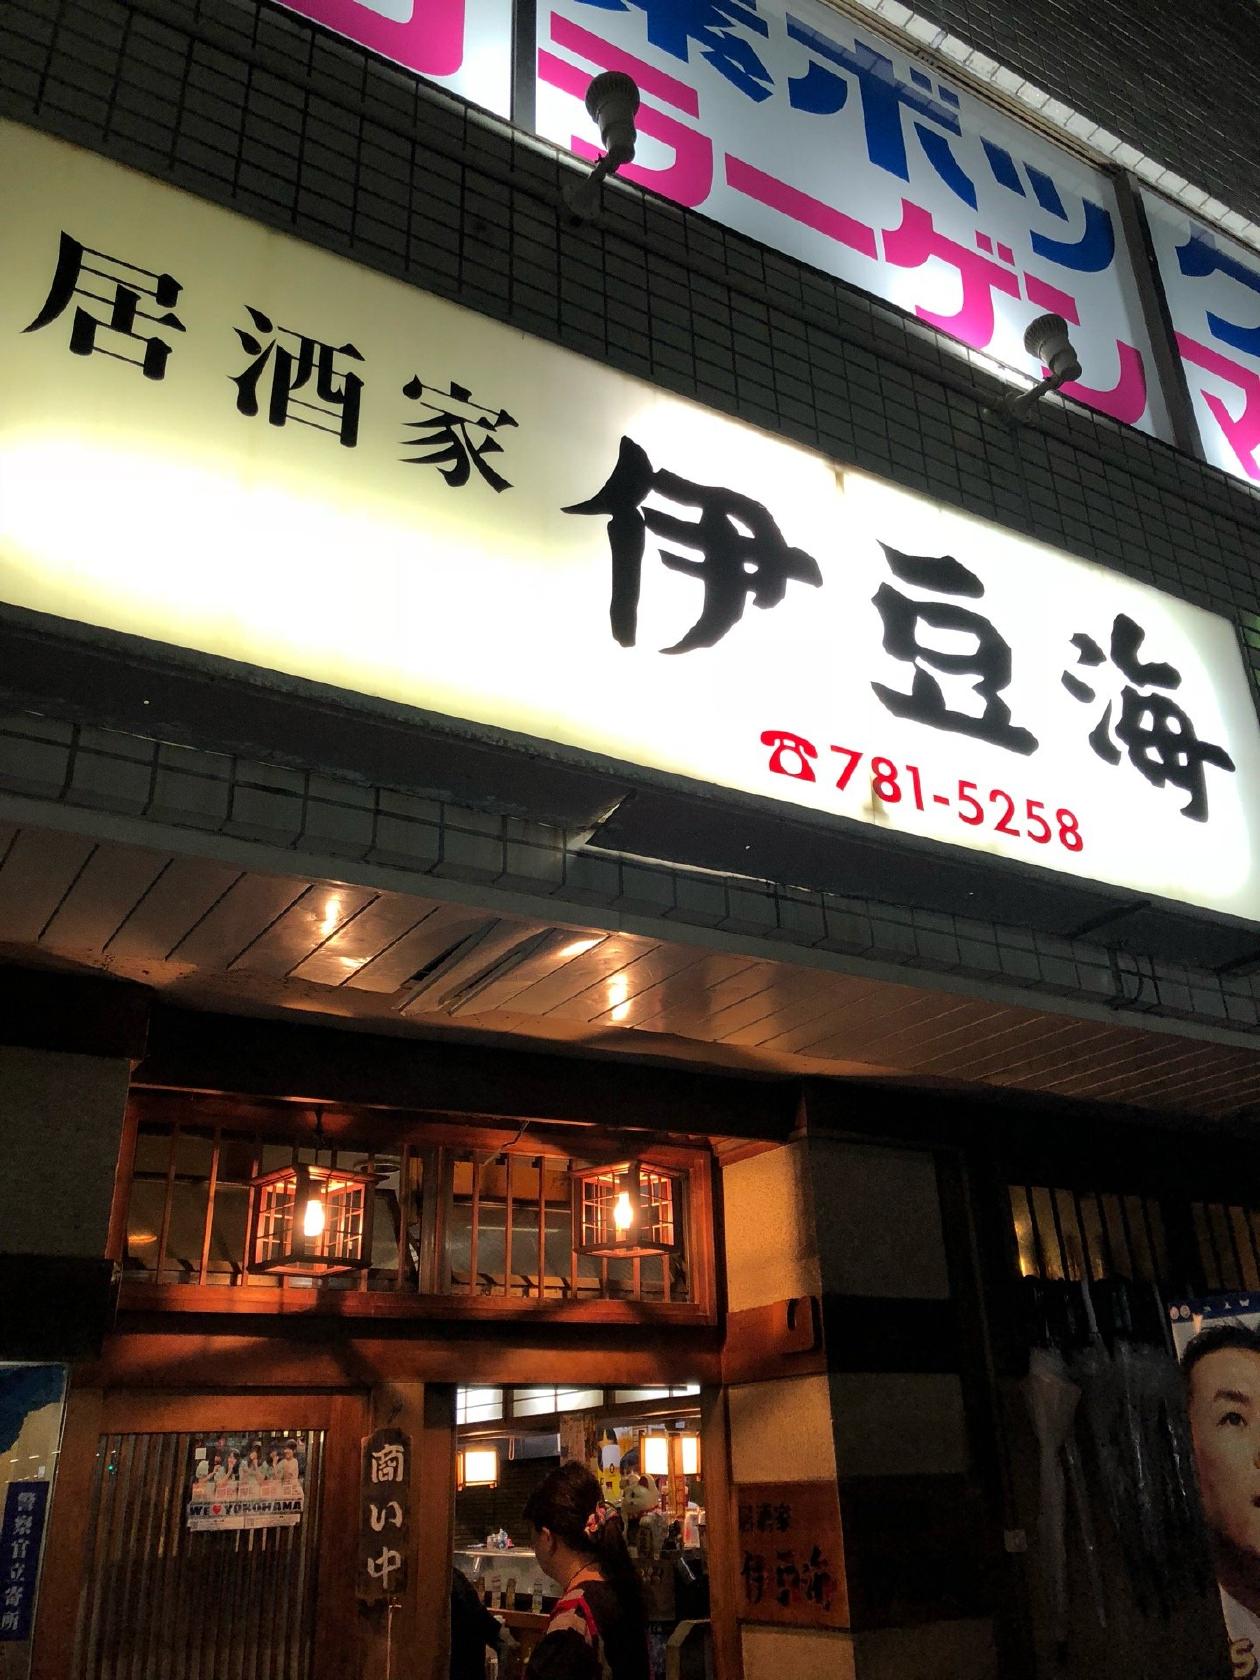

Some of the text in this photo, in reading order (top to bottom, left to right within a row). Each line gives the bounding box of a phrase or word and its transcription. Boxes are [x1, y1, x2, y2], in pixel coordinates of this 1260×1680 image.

[21, 230, 519, 494] 居酒家
[560, 435, 1236, 822] 伊豆海
[829, 744, 1084, 852] 781-5258
[225, 1501, 301, 1514] YOKOHAMA
[367, 1444, 404, 1590] 商い中
